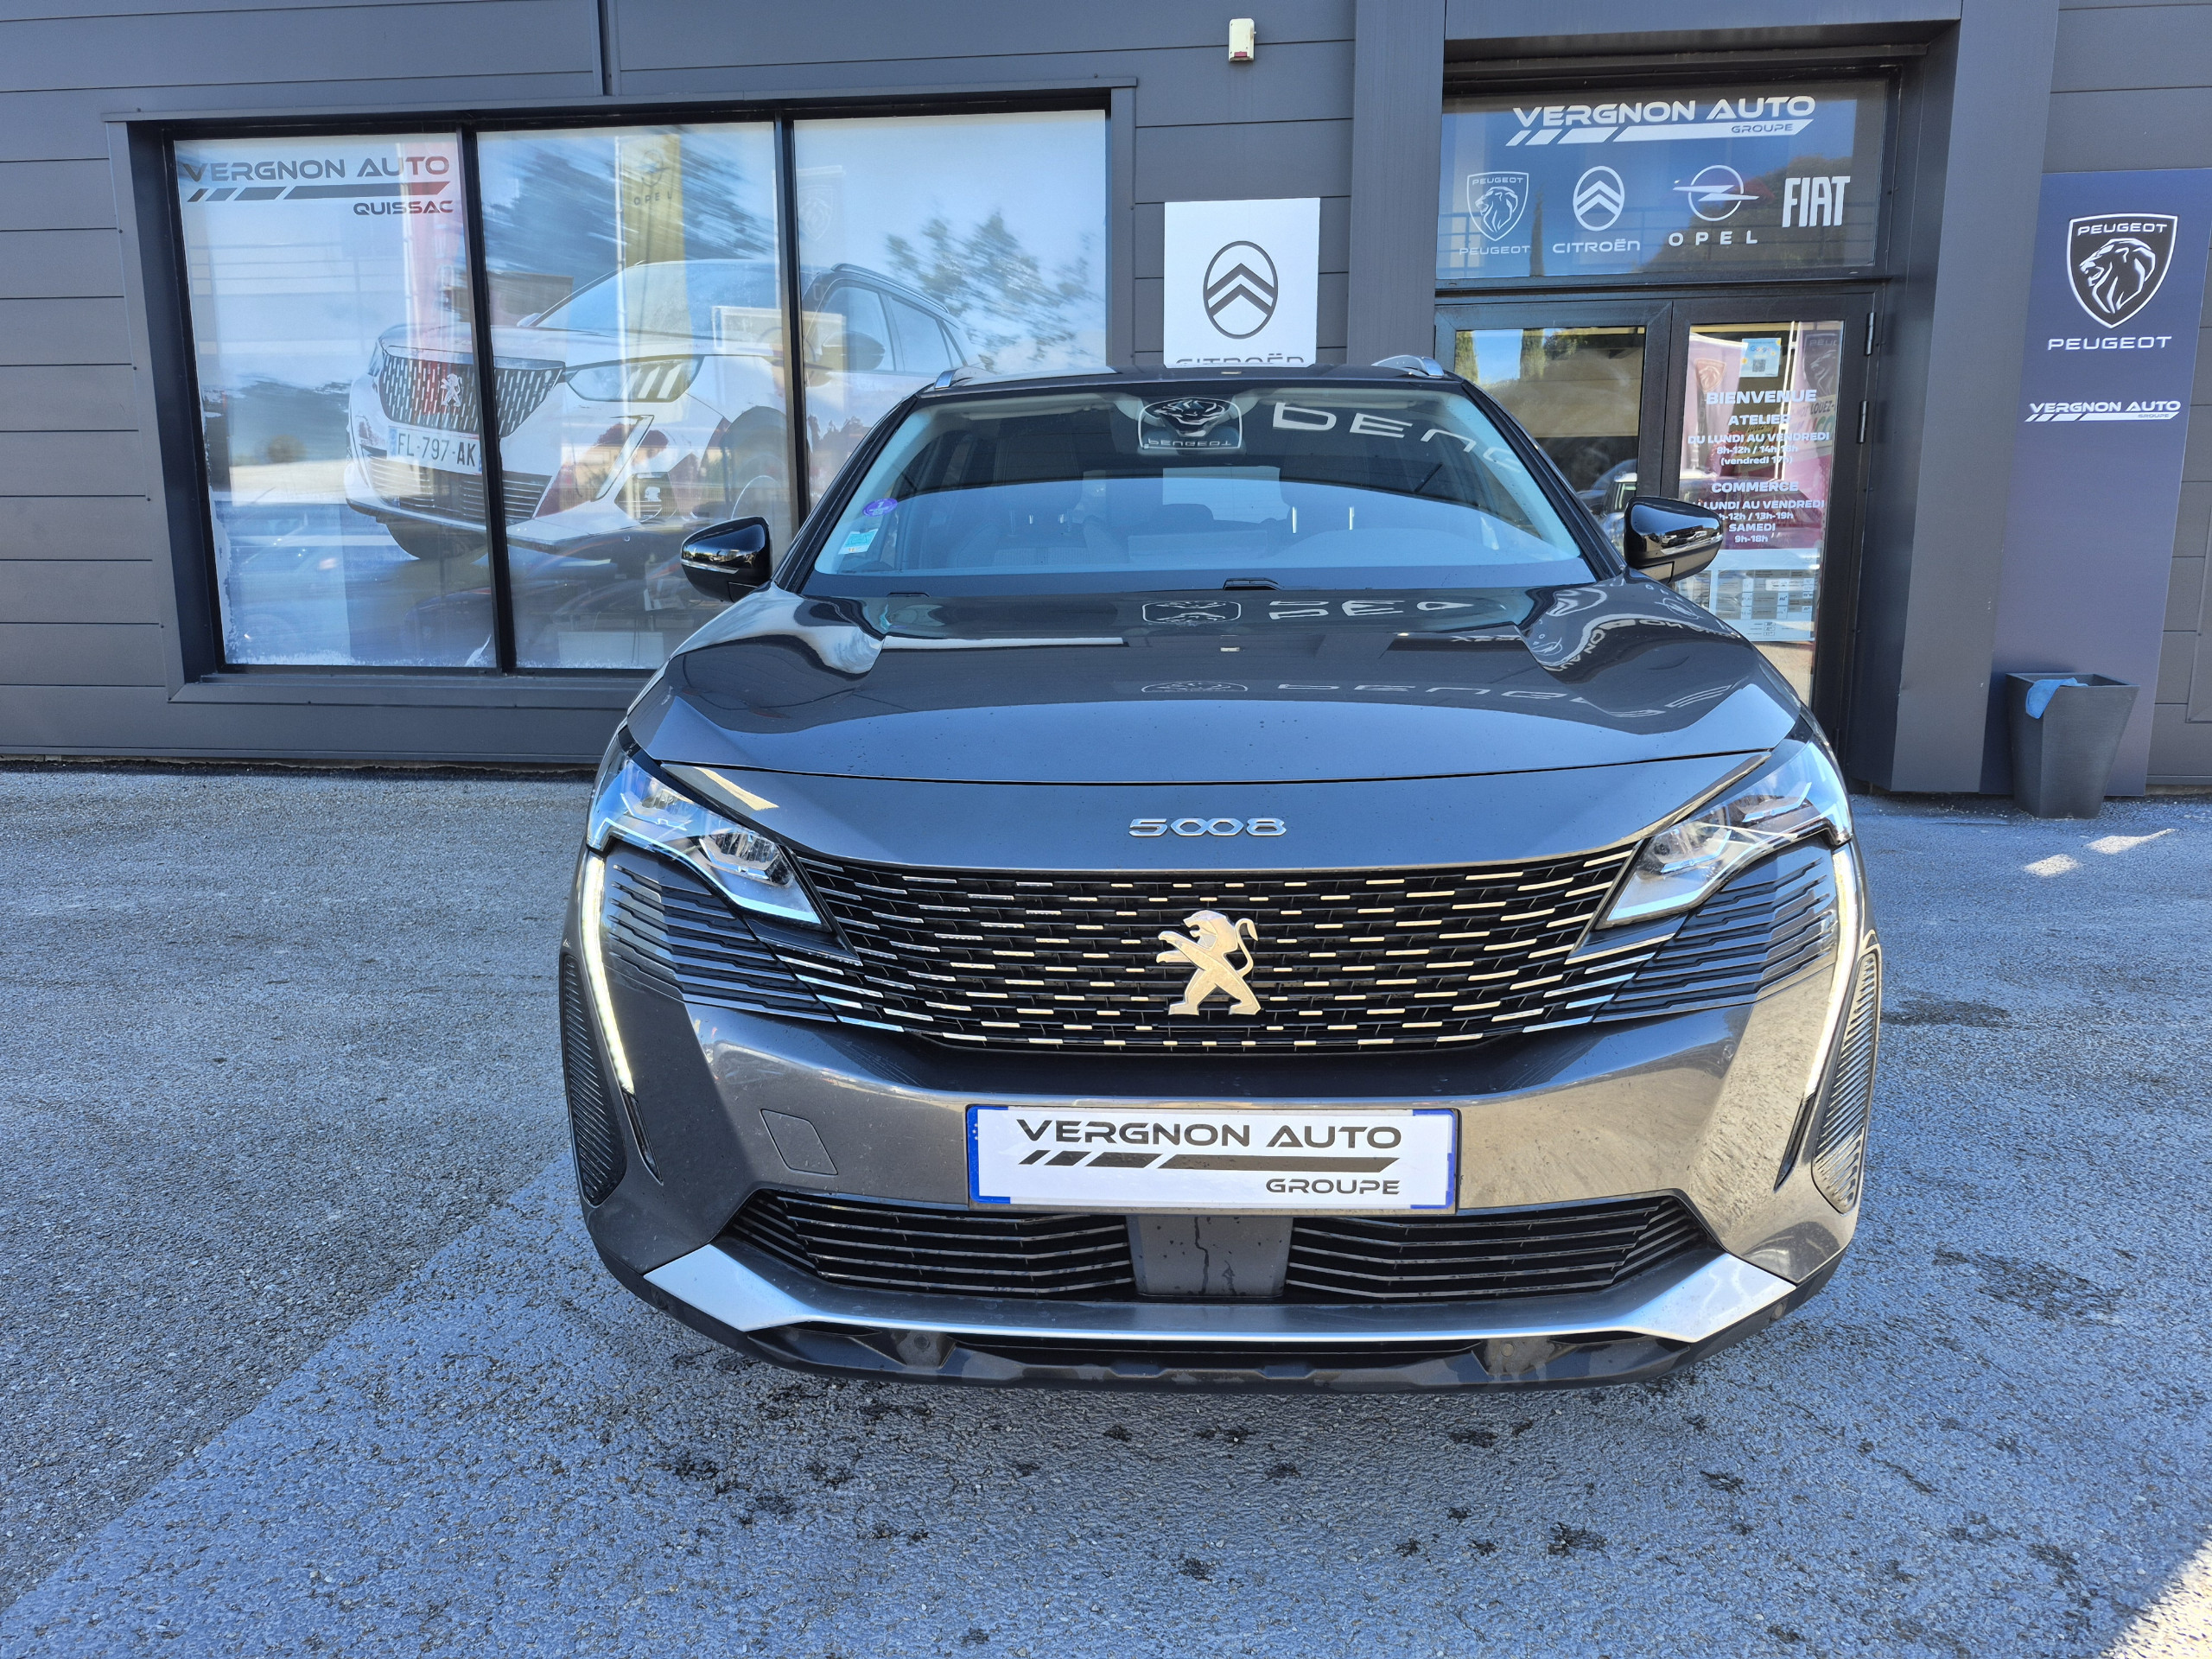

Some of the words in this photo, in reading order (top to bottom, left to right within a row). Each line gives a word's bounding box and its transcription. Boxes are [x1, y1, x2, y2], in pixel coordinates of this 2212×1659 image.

[1512, 100, 1696, 127] VERGNON
[1707, 95, 1816, 120] AUTO
[1731, 123, 1794, 135] GROUPE
[182, 158, 345, 182] VERGNON
[357, 156, 450, 178] AUTO
[1471, 176, 1523, 186] PEUGEOT
[353, 200, 454, 215] QUISSAC
[1782, 175, 1851, 228] FIAT
[2077, 222, 2167, 237] PEUGEOT
[1668, 230, 1758, 246] OPEL
[1459, 245, 1530, 256] PEUGEOT
[2047, 335, 2172, 351] PEUGEOT
[1706, 389, 1817, 405] BIENVENUE
[2029, 401, 2122, 413] VERGNON
[2125, 400, 2182, 412] AUTO
[1728, 414, 1791, 426] ATELIER
[1688, 435, 1706, 444] DU
[1707, 434, 1744, 443] LUNDI
[1746, 433, 1765, 442] AU
[1767, 432, 1830, 442] VENDREDI
[1717, 445, 1751, 454] 8h-12h
[1759, 444, 1799, 454] 14h18h
[1720, 456, 1769, 467] (vendredi
[1712, 481, 1799, 493] COMMERCE
[1704, 500, 1739, 511] LUNDI
[1742, 500, 1760, 510] AU
[1763, 499, 1825, 510] VENDREDI
[1718, 512, 1746, 522] h-12h
[1755, 512, 1794, 521] 13h-19h
[1728, 523, 1776, 532] SAMEDI
[1734, 535, 1768, 543] 9h-18h
[1128, 817, 1287, 837] 5008
[1016, 1118, 1250, 1147] VERGNON
[1265, 1124, 1402, 1149] AUTO
[1265, 1178, 1400, 1195] GROUPE
